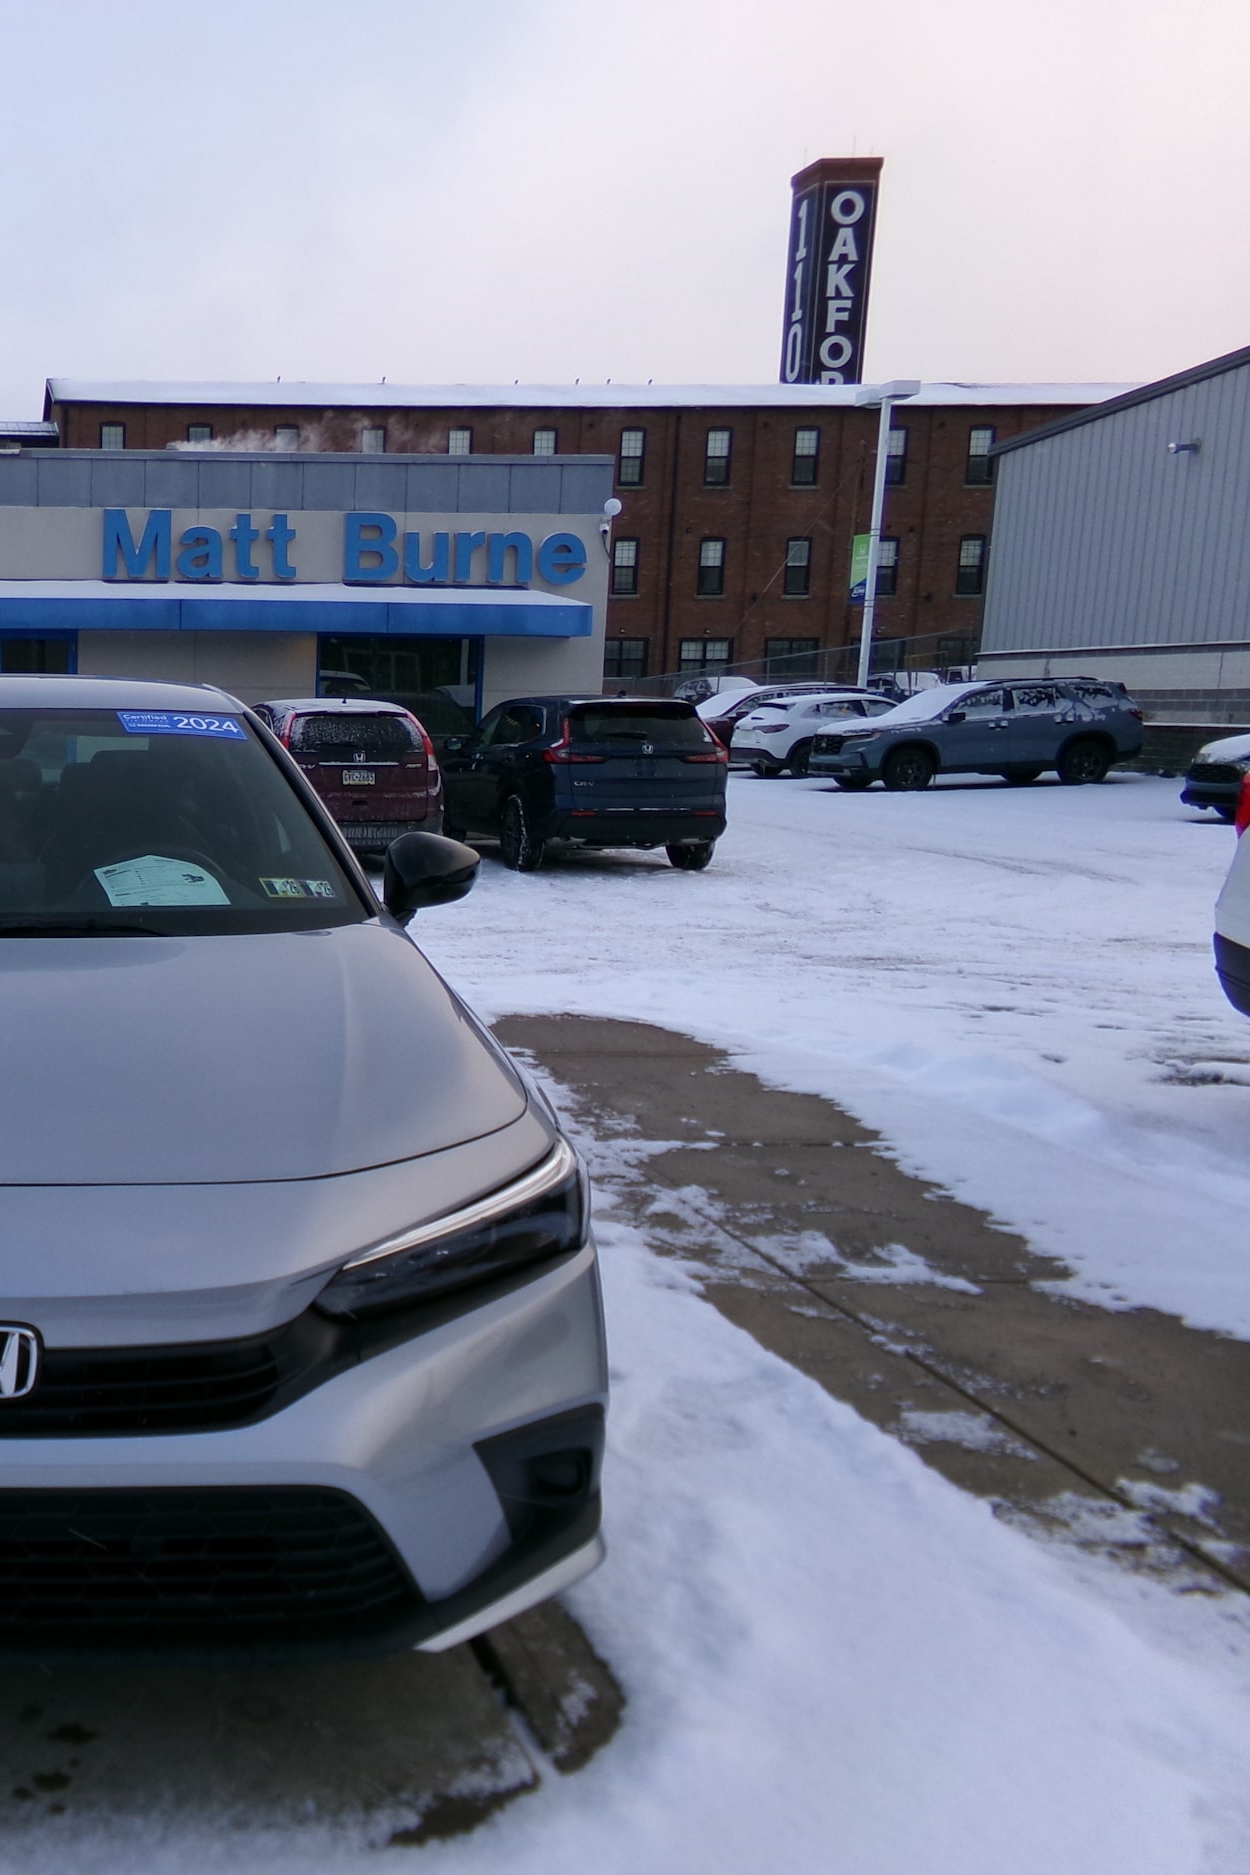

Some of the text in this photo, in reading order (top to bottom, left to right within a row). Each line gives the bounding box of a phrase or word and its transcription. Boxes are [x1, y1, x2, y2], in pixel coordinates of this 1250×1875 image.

[103, 508, 587, 585] Matt Burne
[173, 716, 239, 733] 2024
